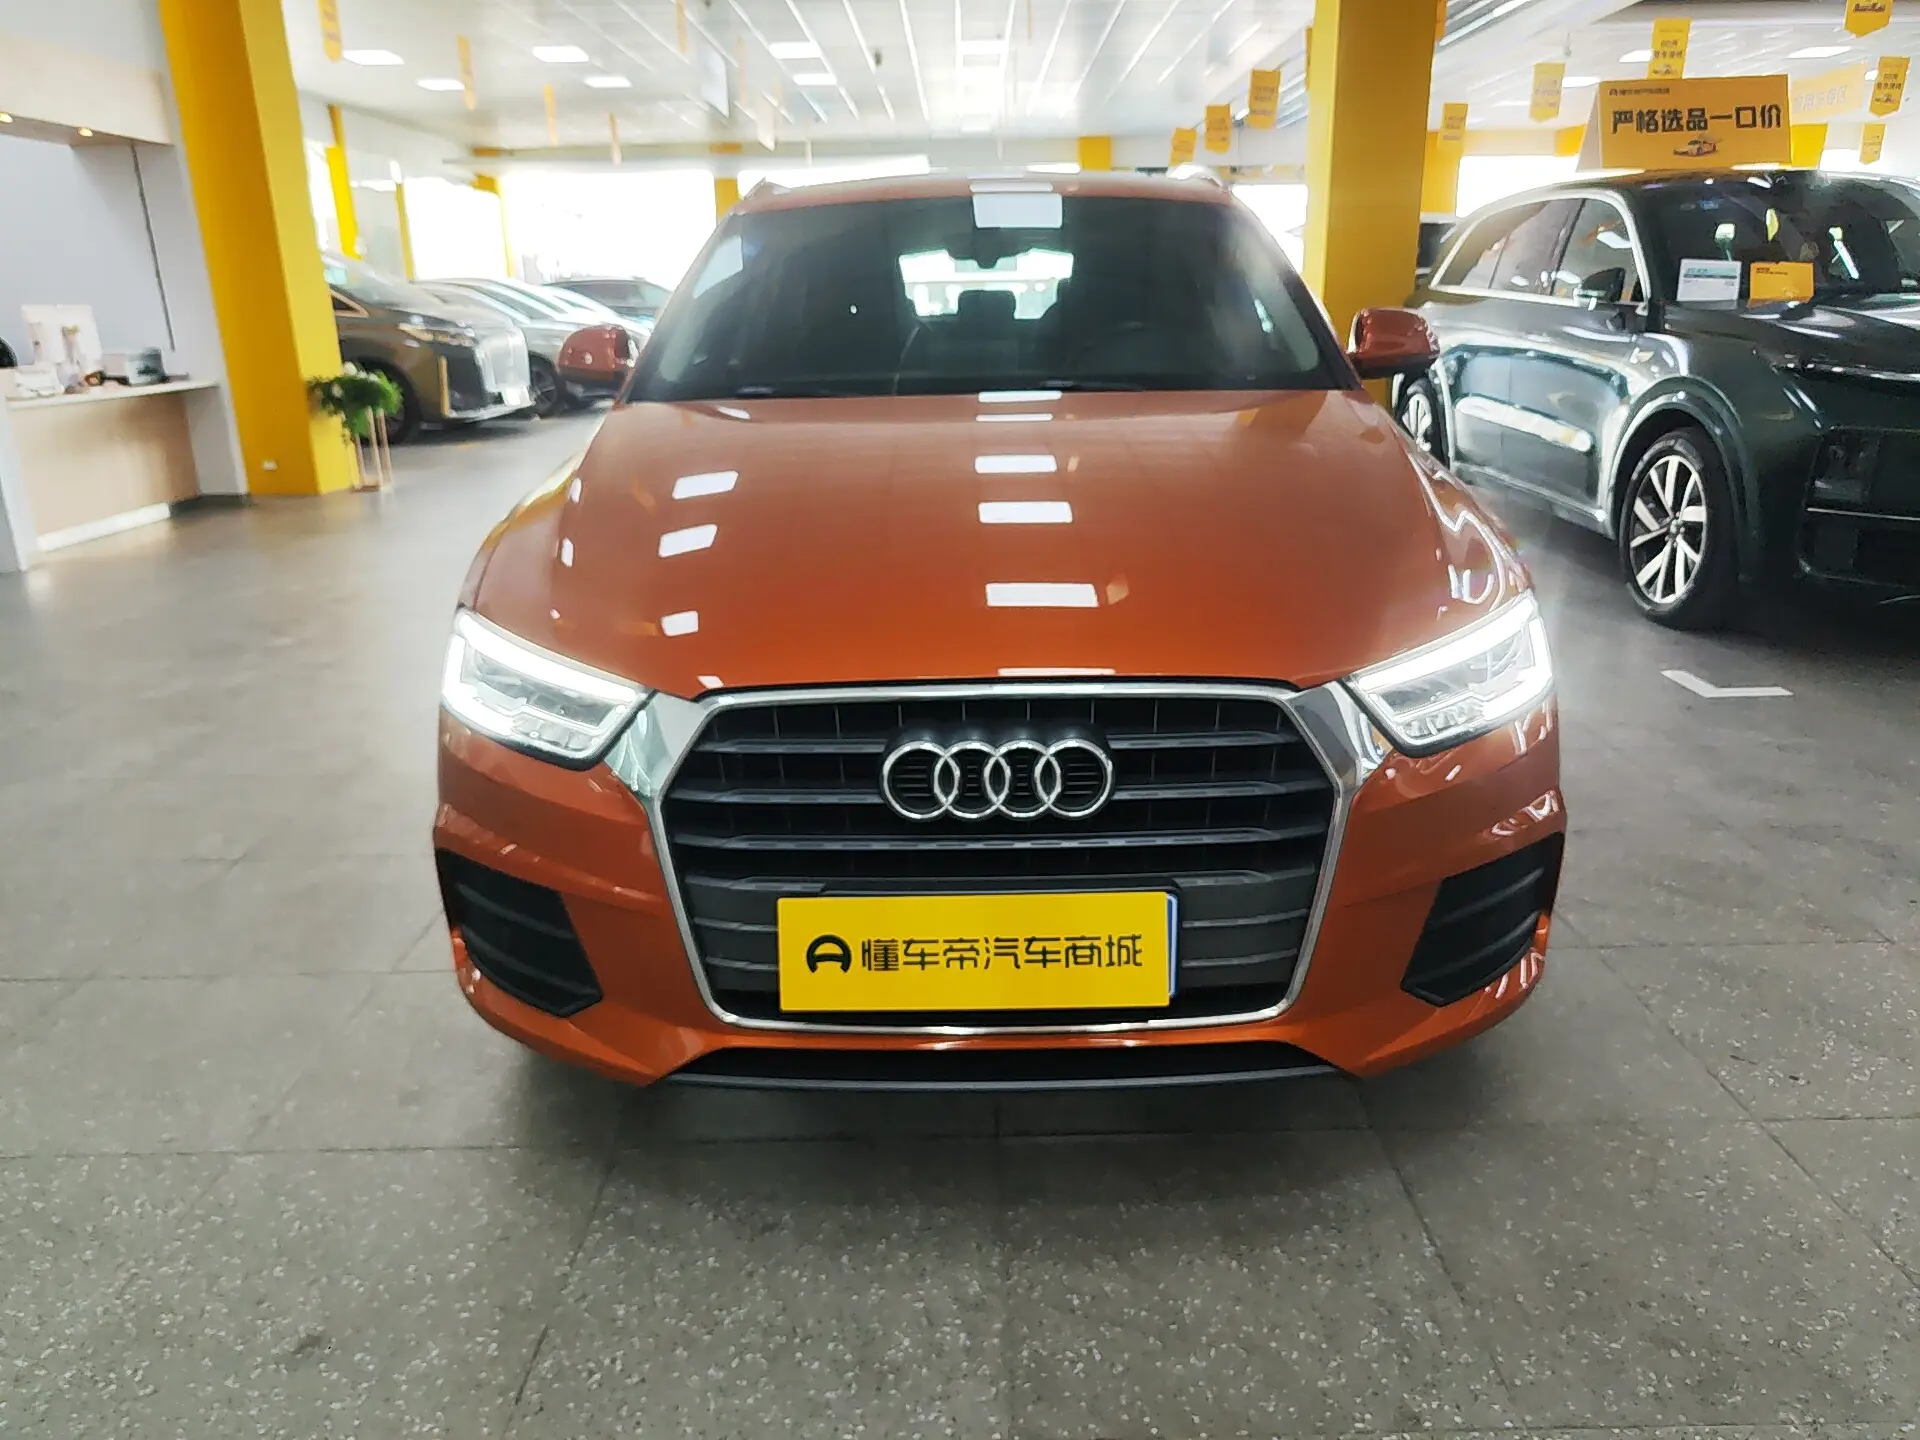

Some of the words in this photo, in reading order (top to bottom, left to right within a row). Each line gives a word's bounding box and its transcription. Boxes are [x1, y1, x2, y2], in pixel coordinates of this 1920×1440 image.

[1611, 104, 1781, 134] 严格选品一口价
[861, 933, 1143, 971] 懂车帝汽车商城
